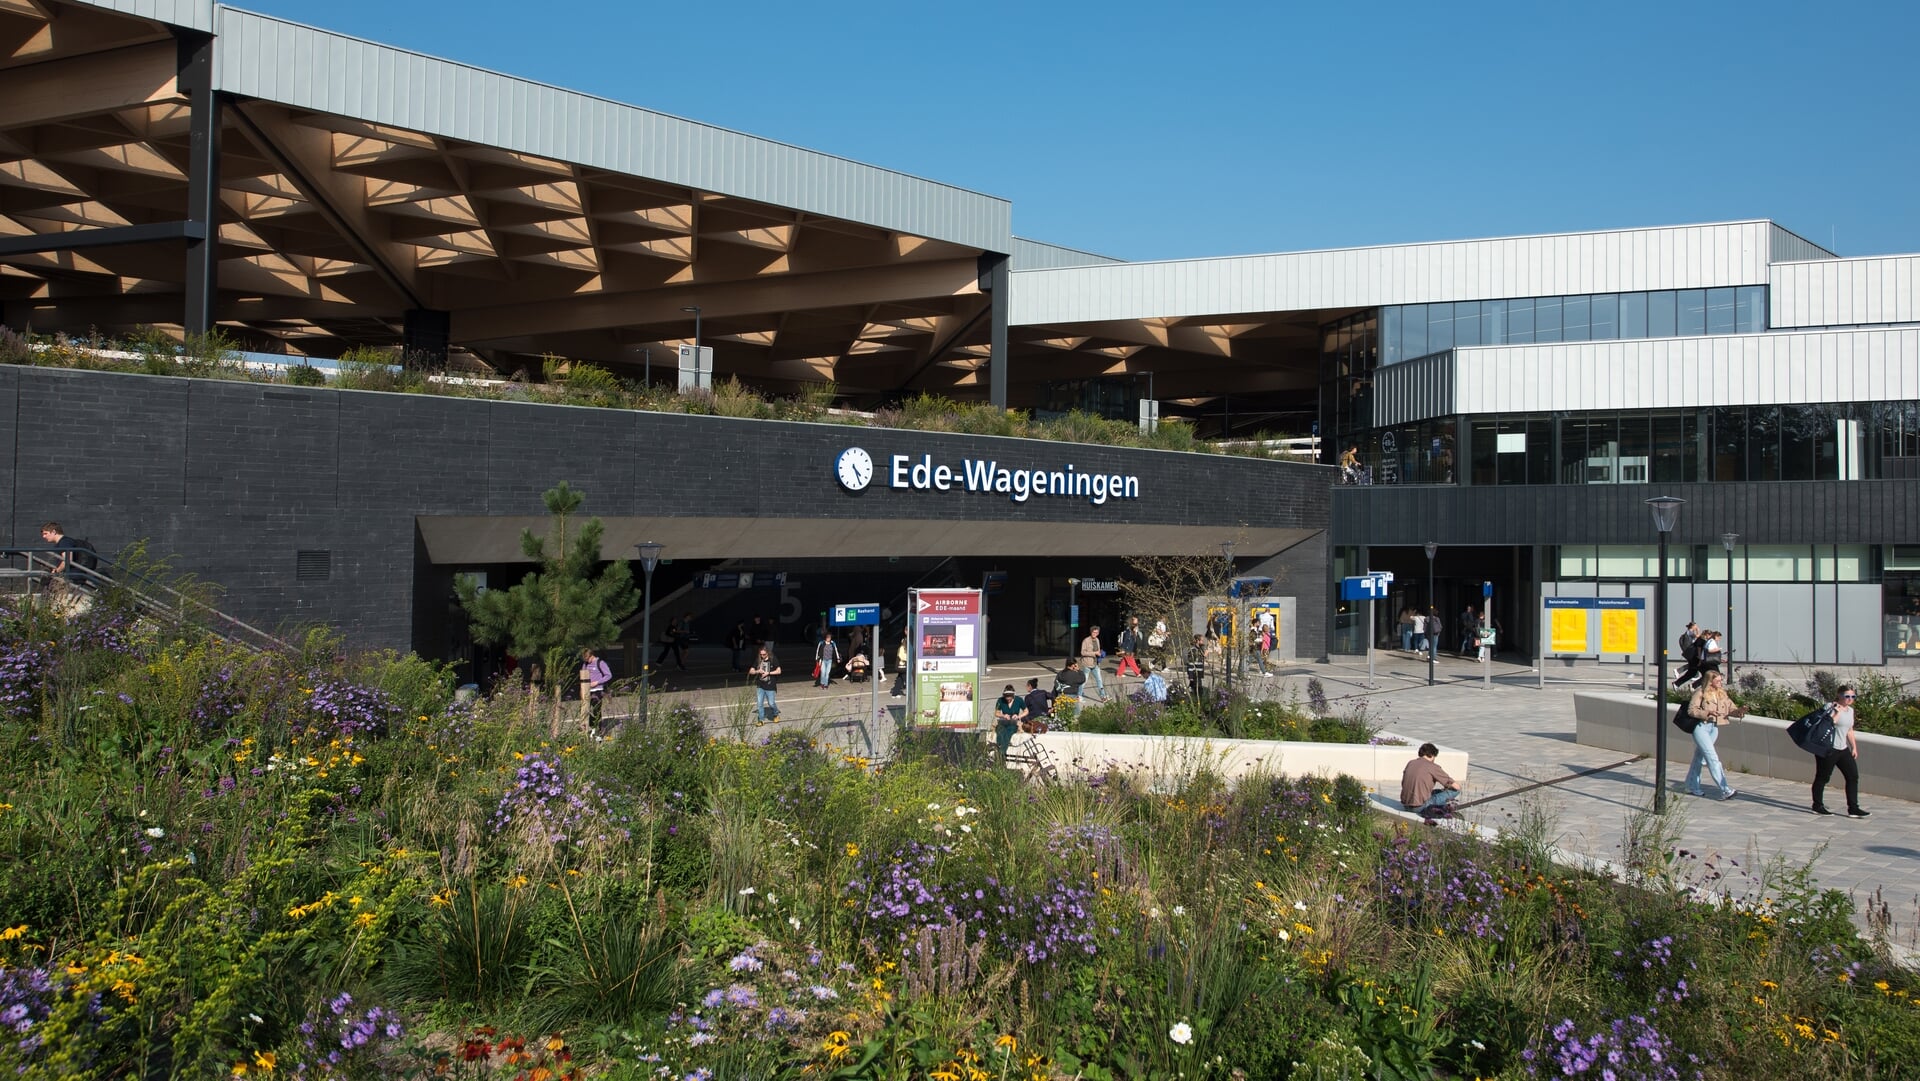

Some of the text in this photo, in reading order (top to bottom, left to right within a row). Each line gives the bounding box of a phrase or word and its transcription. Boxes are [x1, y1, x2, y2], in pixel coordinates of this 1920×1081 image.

[890, 454, 1139, 504] Ede-Wageningen
[780, 582, 802, 623] 5
[1081, 581, 1119, 591] HUISKAMER
